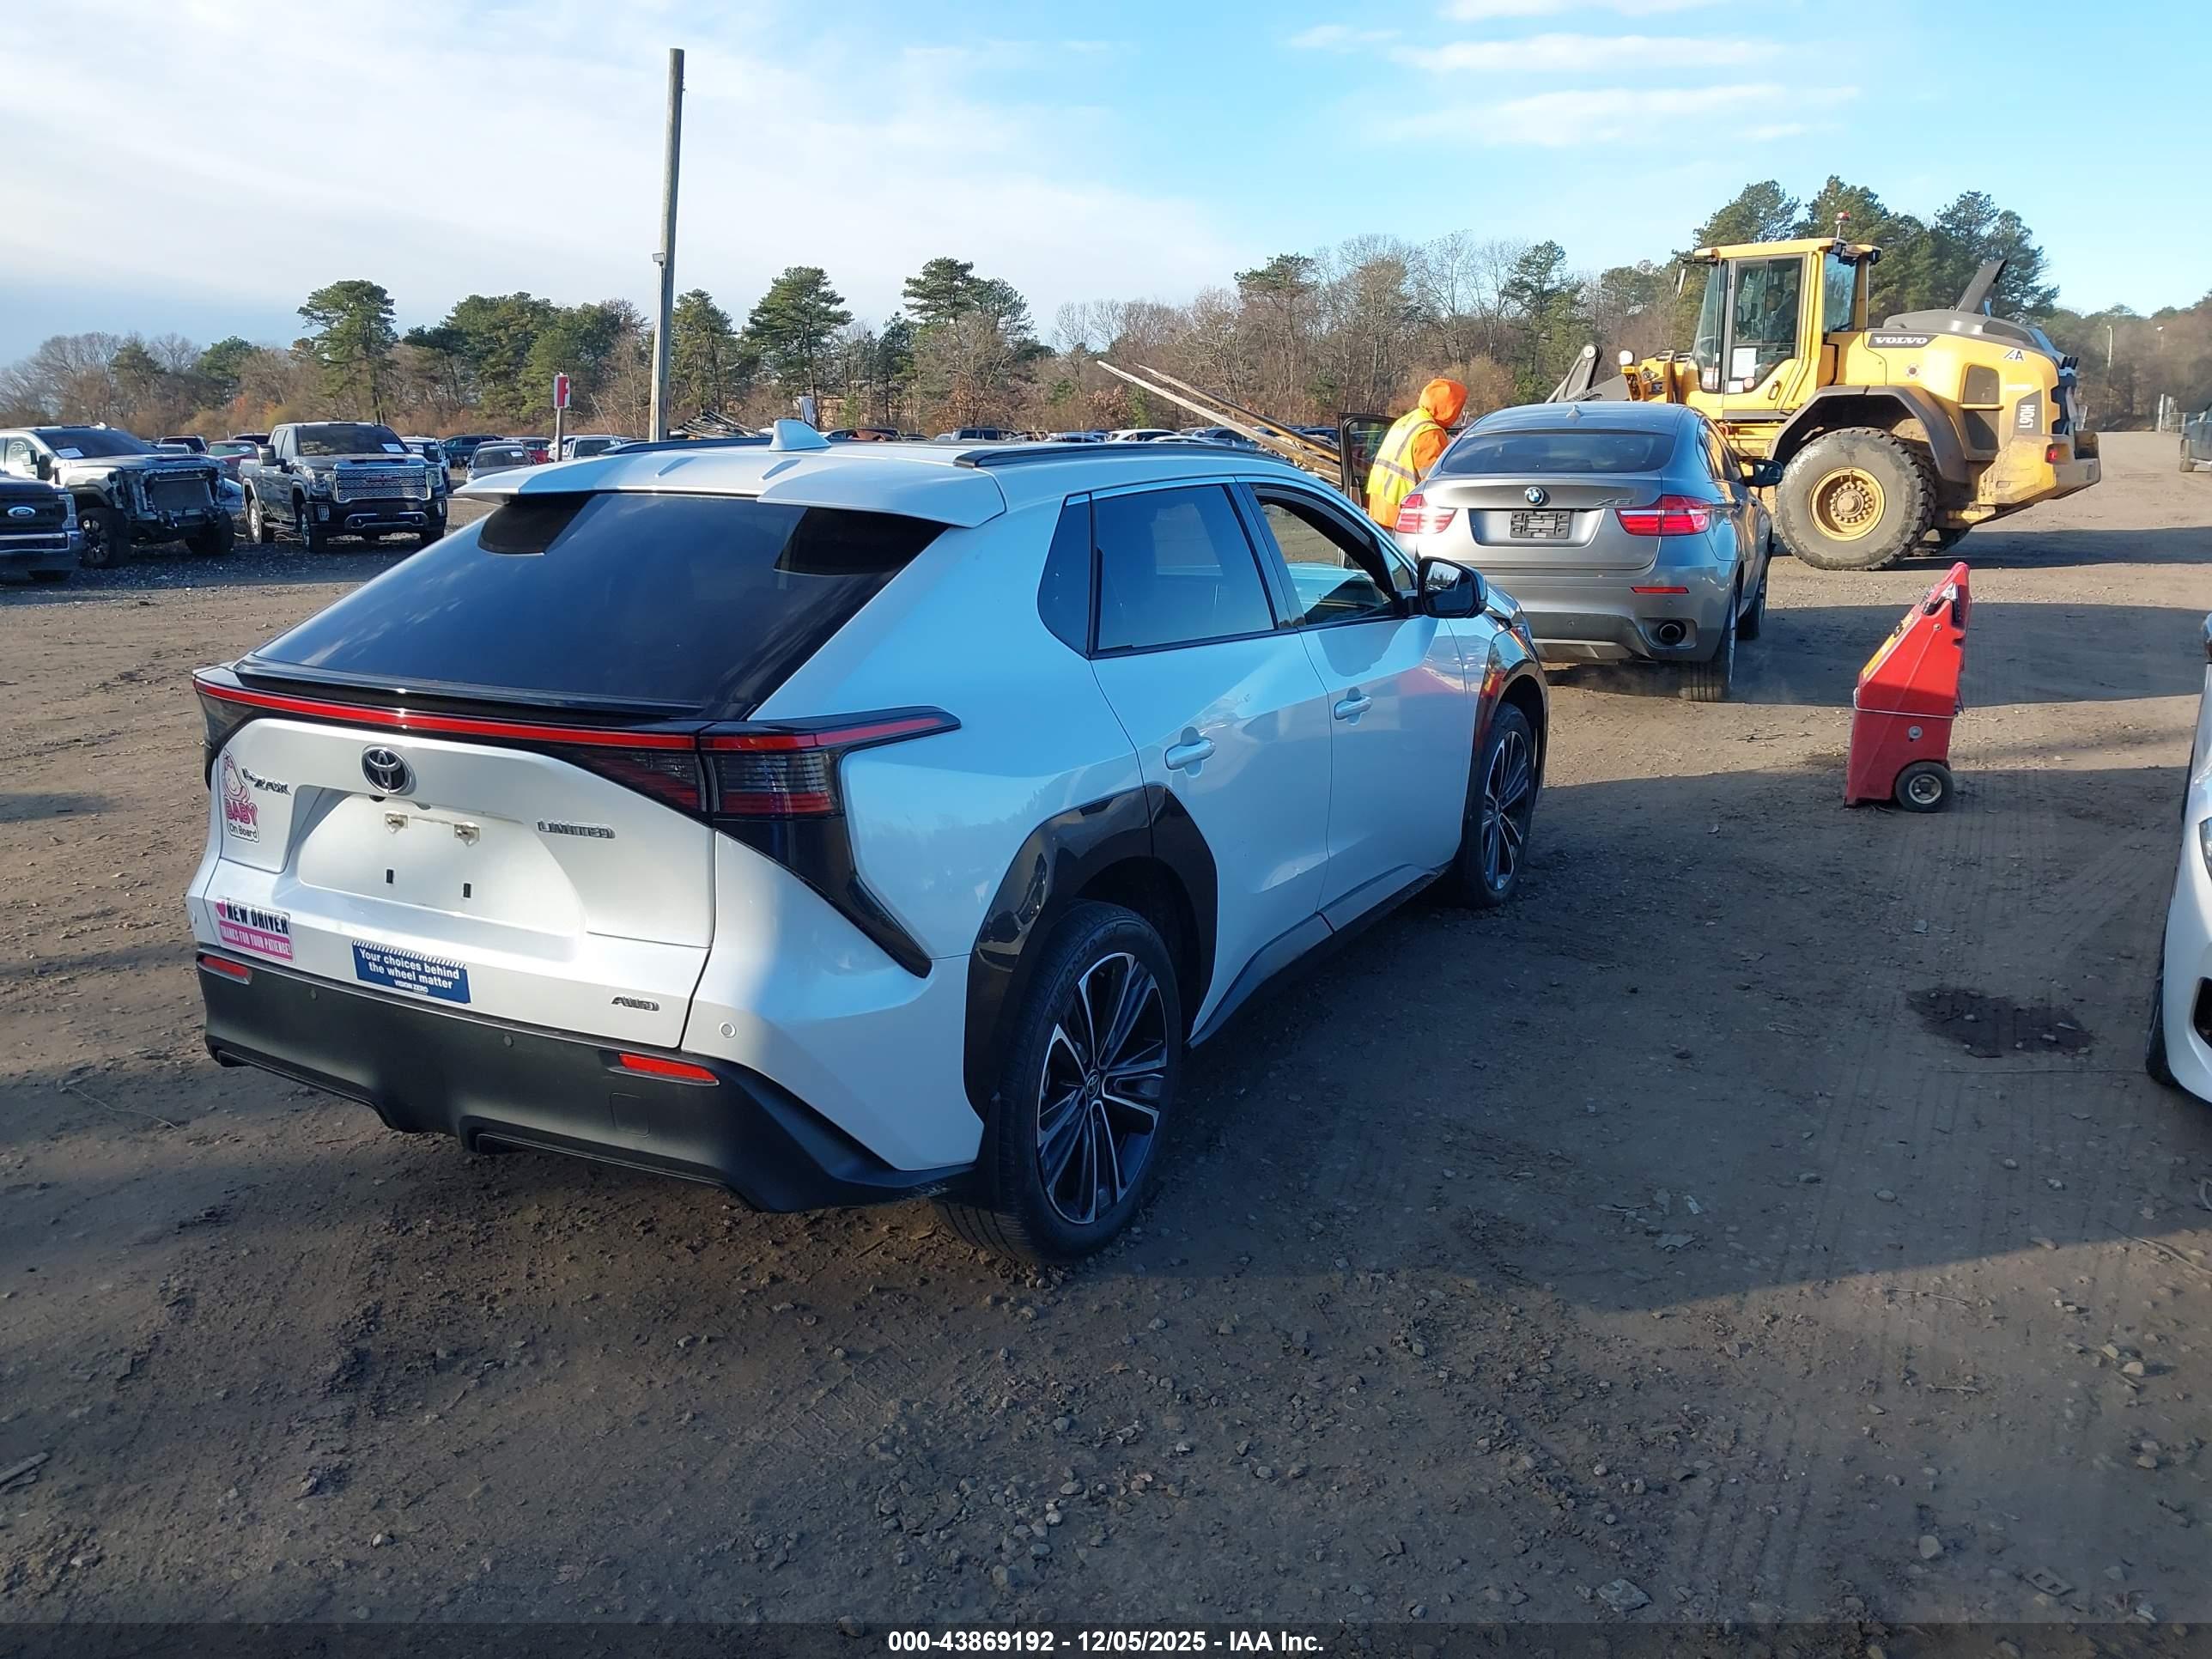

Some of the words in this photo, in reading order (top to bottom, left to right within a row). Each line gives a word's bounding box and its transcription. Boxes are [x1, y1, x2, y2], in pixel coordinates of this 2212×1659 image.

[1874, 336, 1929, 344] VOLVO
[2019, 404, 2036, 428] L90H
[224, 797, 257, 826] BABY
[229, 823, 239, 834] On
[239, 824, 258, 839] Board
[227, 901, 247, 924] NEW
[251, 908, 289, 934] DRIVER
[359, 948, 380, 963] Your
[384, 955, 421, 972] choices
[424, 963, 459, 980] behind
[368, 962, 385, 974] the
[386, 967, 416, 981] wheel
[419, 975, 453, 989] matter
[394, 980, 412, 989] VISION
[413, 984, 428, 994] ZERO
[611, 996, 659, 1012] AWD
